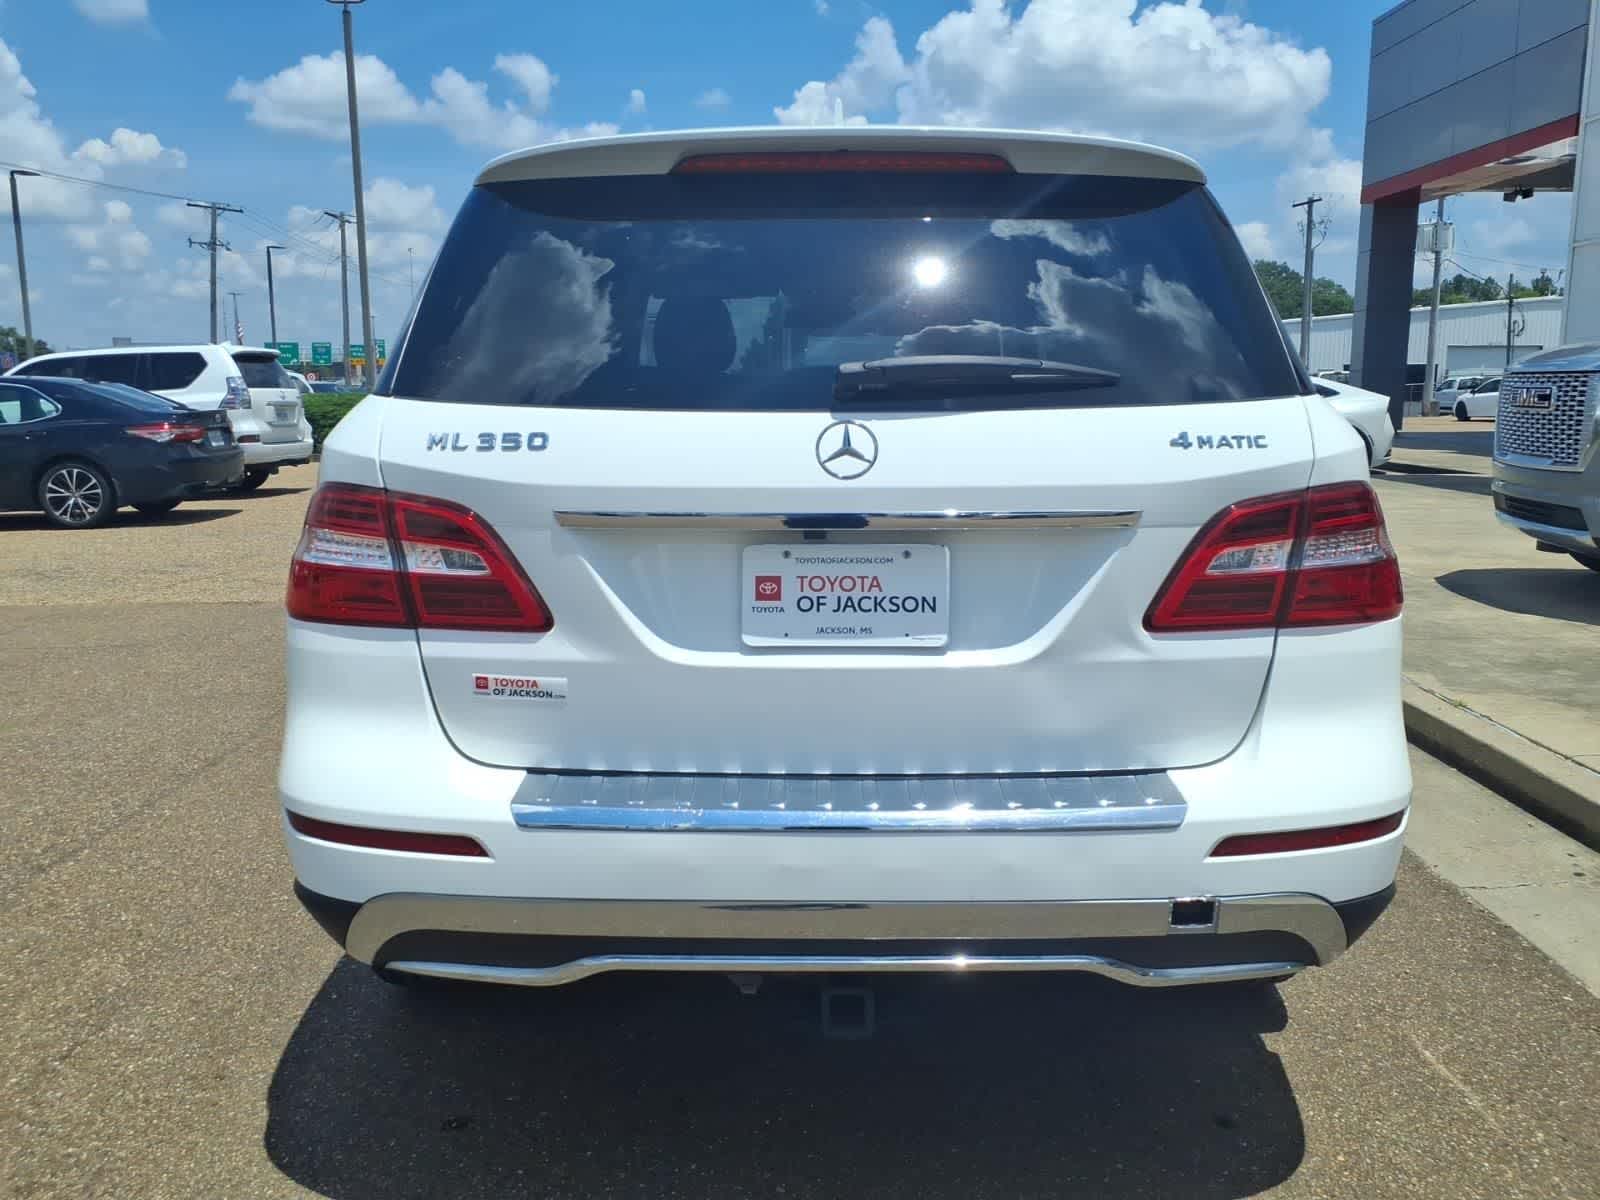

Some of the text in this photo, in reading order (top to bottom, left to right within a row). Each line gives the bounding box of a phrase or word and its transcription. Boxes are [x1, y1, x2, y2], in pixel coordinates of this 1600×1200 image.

[1511, 388, 1551, 407] GMC
[426, 431, 550, 453] ML 350
[795, 556, 894, 565] TOYOTAOFJACKSON.COM
[796, 576, 883, 593] TOYOTA
[796, 595, 938, 614] OF JACKSON
[815, 626, 873, 635] JACKSON, MS
[493, 678, 539, 688] TOYOTA
[493, 688, 505, 696] OF
[507, 689, 553, 698] JACKSON
